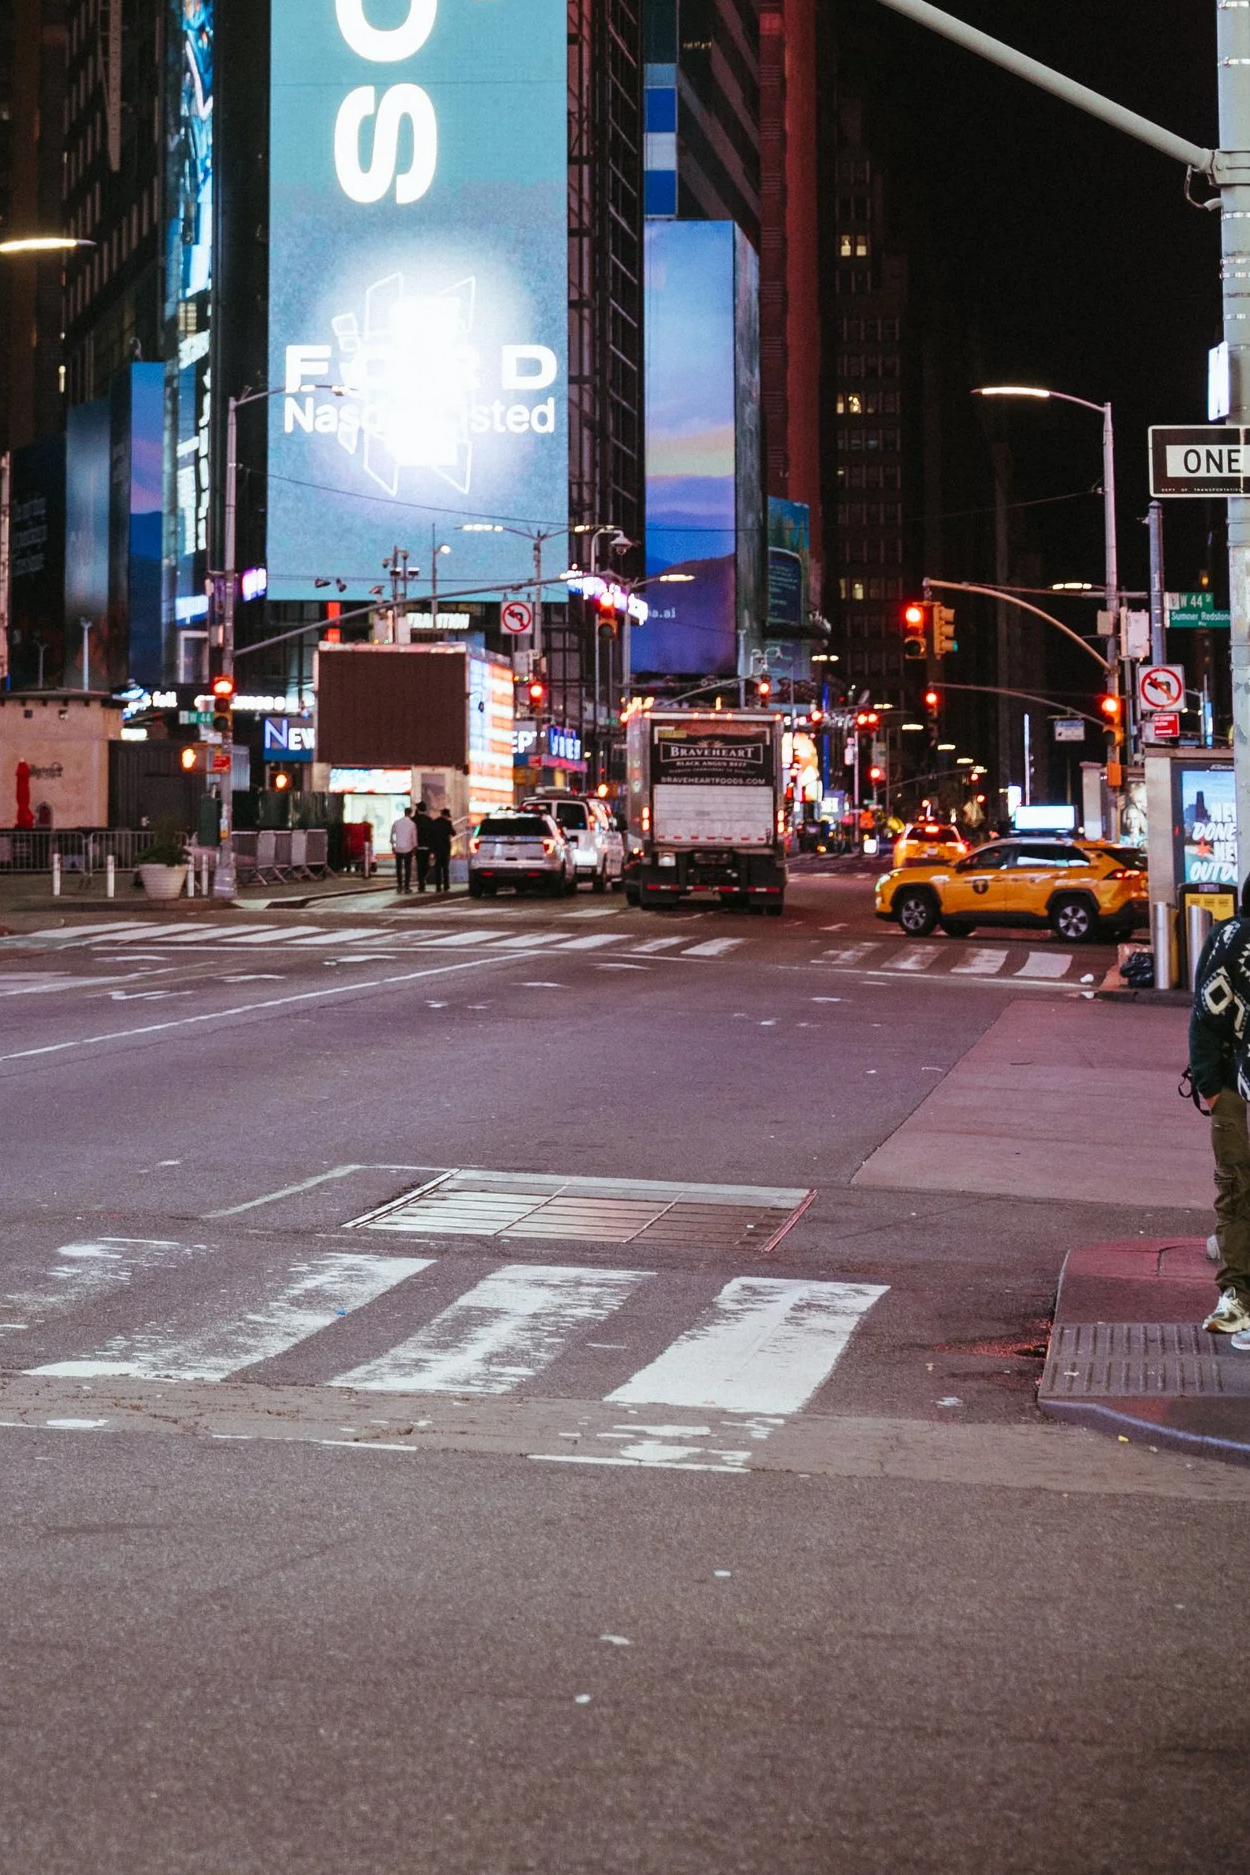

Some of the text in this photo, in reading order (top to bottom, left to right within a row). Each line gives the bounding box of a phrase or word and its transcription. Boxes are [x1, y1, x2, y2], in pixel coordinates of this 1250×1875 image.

[1183, 449, 1242, 474] ONE
[1180, 595, 1187, 607] W
[1190, 594, 1203, 608] 44
[1171, 611, 1199, 621] Sumner
[670, 745, 755, 759] BRAVEHEART
